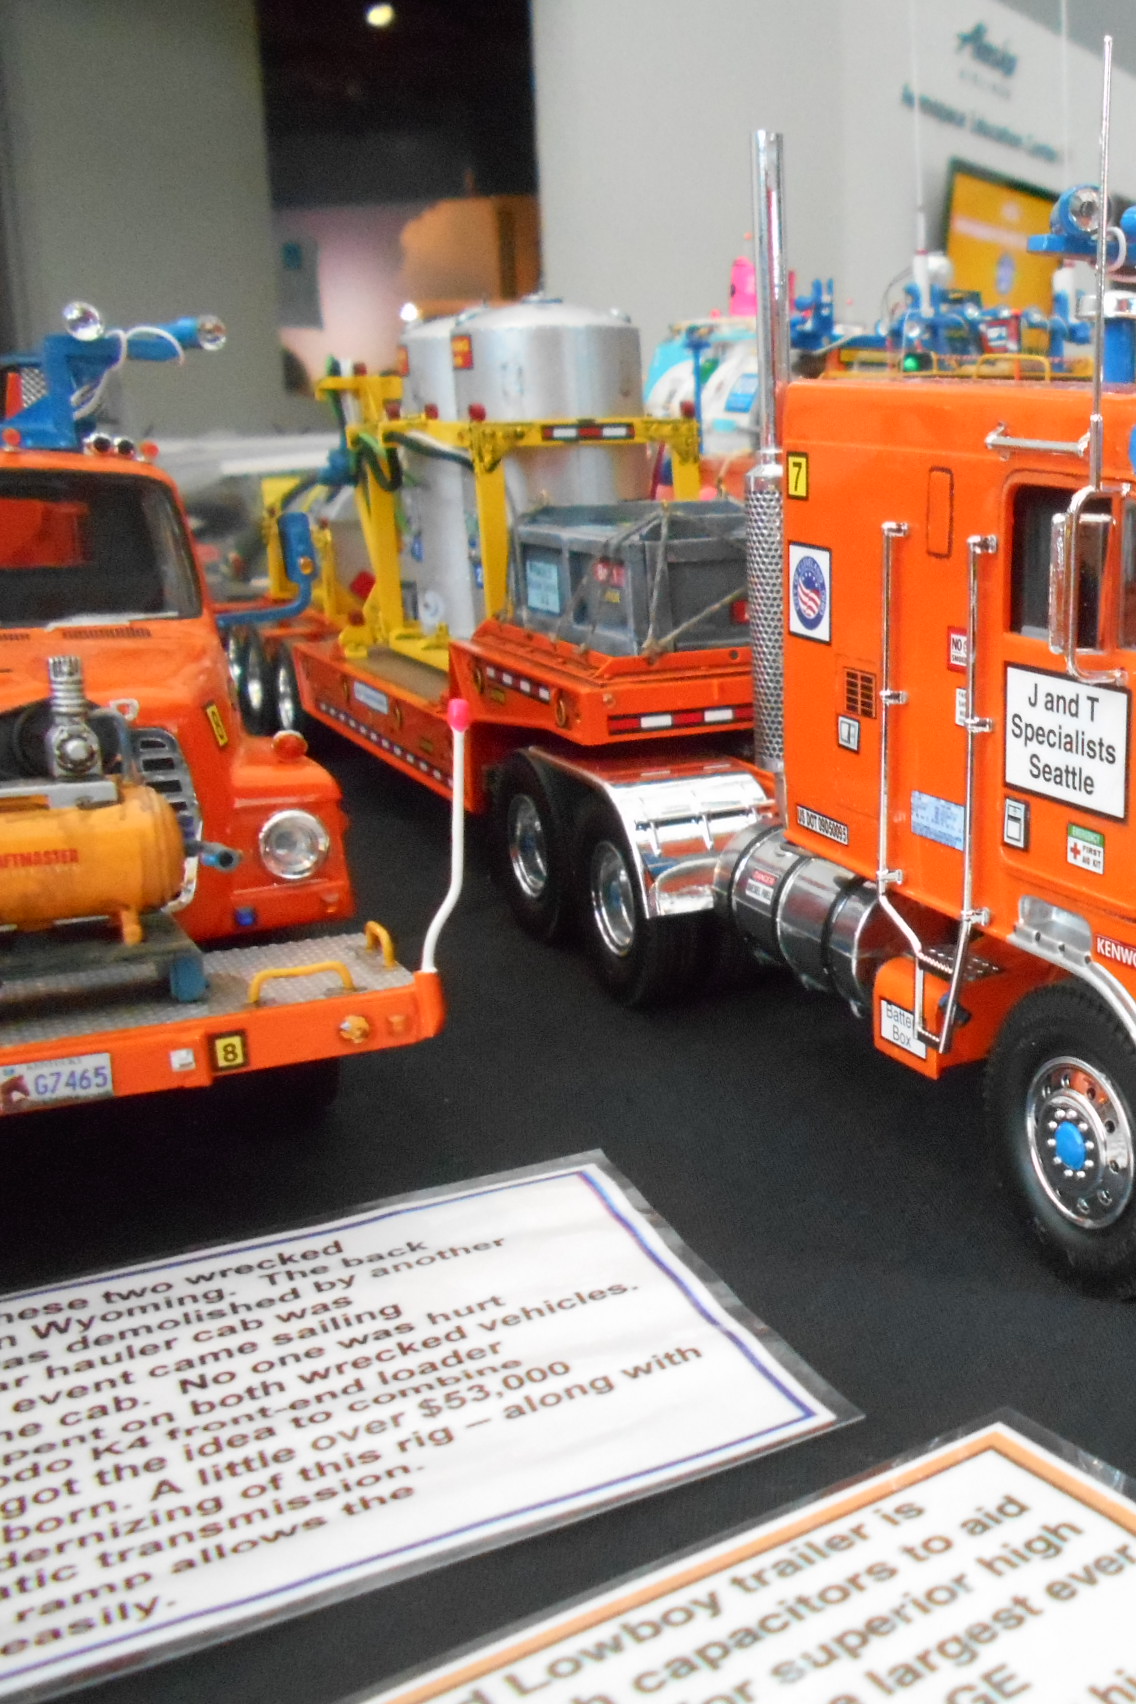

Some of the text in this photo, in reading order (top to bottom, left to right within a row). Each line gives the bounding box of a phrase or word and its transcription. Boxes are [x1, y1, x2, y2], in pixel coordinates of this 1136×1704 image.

[792, 461, 802, 491] 7
[952, 638, 963, 651] NO
[1011, 713, 1116, 765] Specialists
[1028, 683, 1100, 722] J and T
[1029, 753, 1095, 796] Seattle
[1082, 845, 1101, 858] FIRST
[223, 1043, 238, 1062] 8
[886, 1003, 912, 1029] Batte
[892, 1023, 911, 1047] Box
[34, 1066, 108, 1095] G7465
[32, 1288, 236, 1339] Wyoming.
[260, 1265, 329, 1286] The
[341, 1241, 428, 1268] back
[67, 1287, 300, 1353] demolished
[313, 1274, 355, 1292] by
[371, 1237, 505, 1278] another
[102, 1282, 173, 1304] two
[185, 1240, 343, 1285] wrecked
[2, 1283, 639, 1466] pent on both wrecked vehicles.
[12, 1303, 402, 1413] event came sailing
[46, 1336, 178, 1379] hauler
[193, 1317, 263, 1343] cab
[275, 1296, 353, 1323] was
[60, 1396, 150, 1426] cab.
[179, 1371, 236, 1395] No
[252, 1346, 325, 1374] one
[337, 1322, 415, 1349] was
[427, 1295, 505, 1325] hurt
[0, 1359, 522, 1520] got the idea to combine
[91, 1436, 150, 1460] K4
[166, 1378, 365, 1440] front-end
[378, 1341, 502, 1385] loader
[241, 1473, 282, 1499] of
[298, 1450, 381, 1482] this
[398, 1426, 454, 1452] rig
[502, 1374, 615, 1420] along
[621, 1346, 702, 1380] with
[2, 1360, 571, 1544] born. A little over $53,000
[16, 1487, 414, 1623] ramp allows the
[98, 1464, 424, 1567] transmission.
[1, 1596, 176, 1656] easily.
[504, 1500, 926, 1696] Lowboy trailer is
[634, 1494, 1030, 1694] capacitors to aid
[771, 1571, 974, 1684] superior
[975, 1518, 1085, 1577] high
[865, 1594, 1044, 1697] largest
